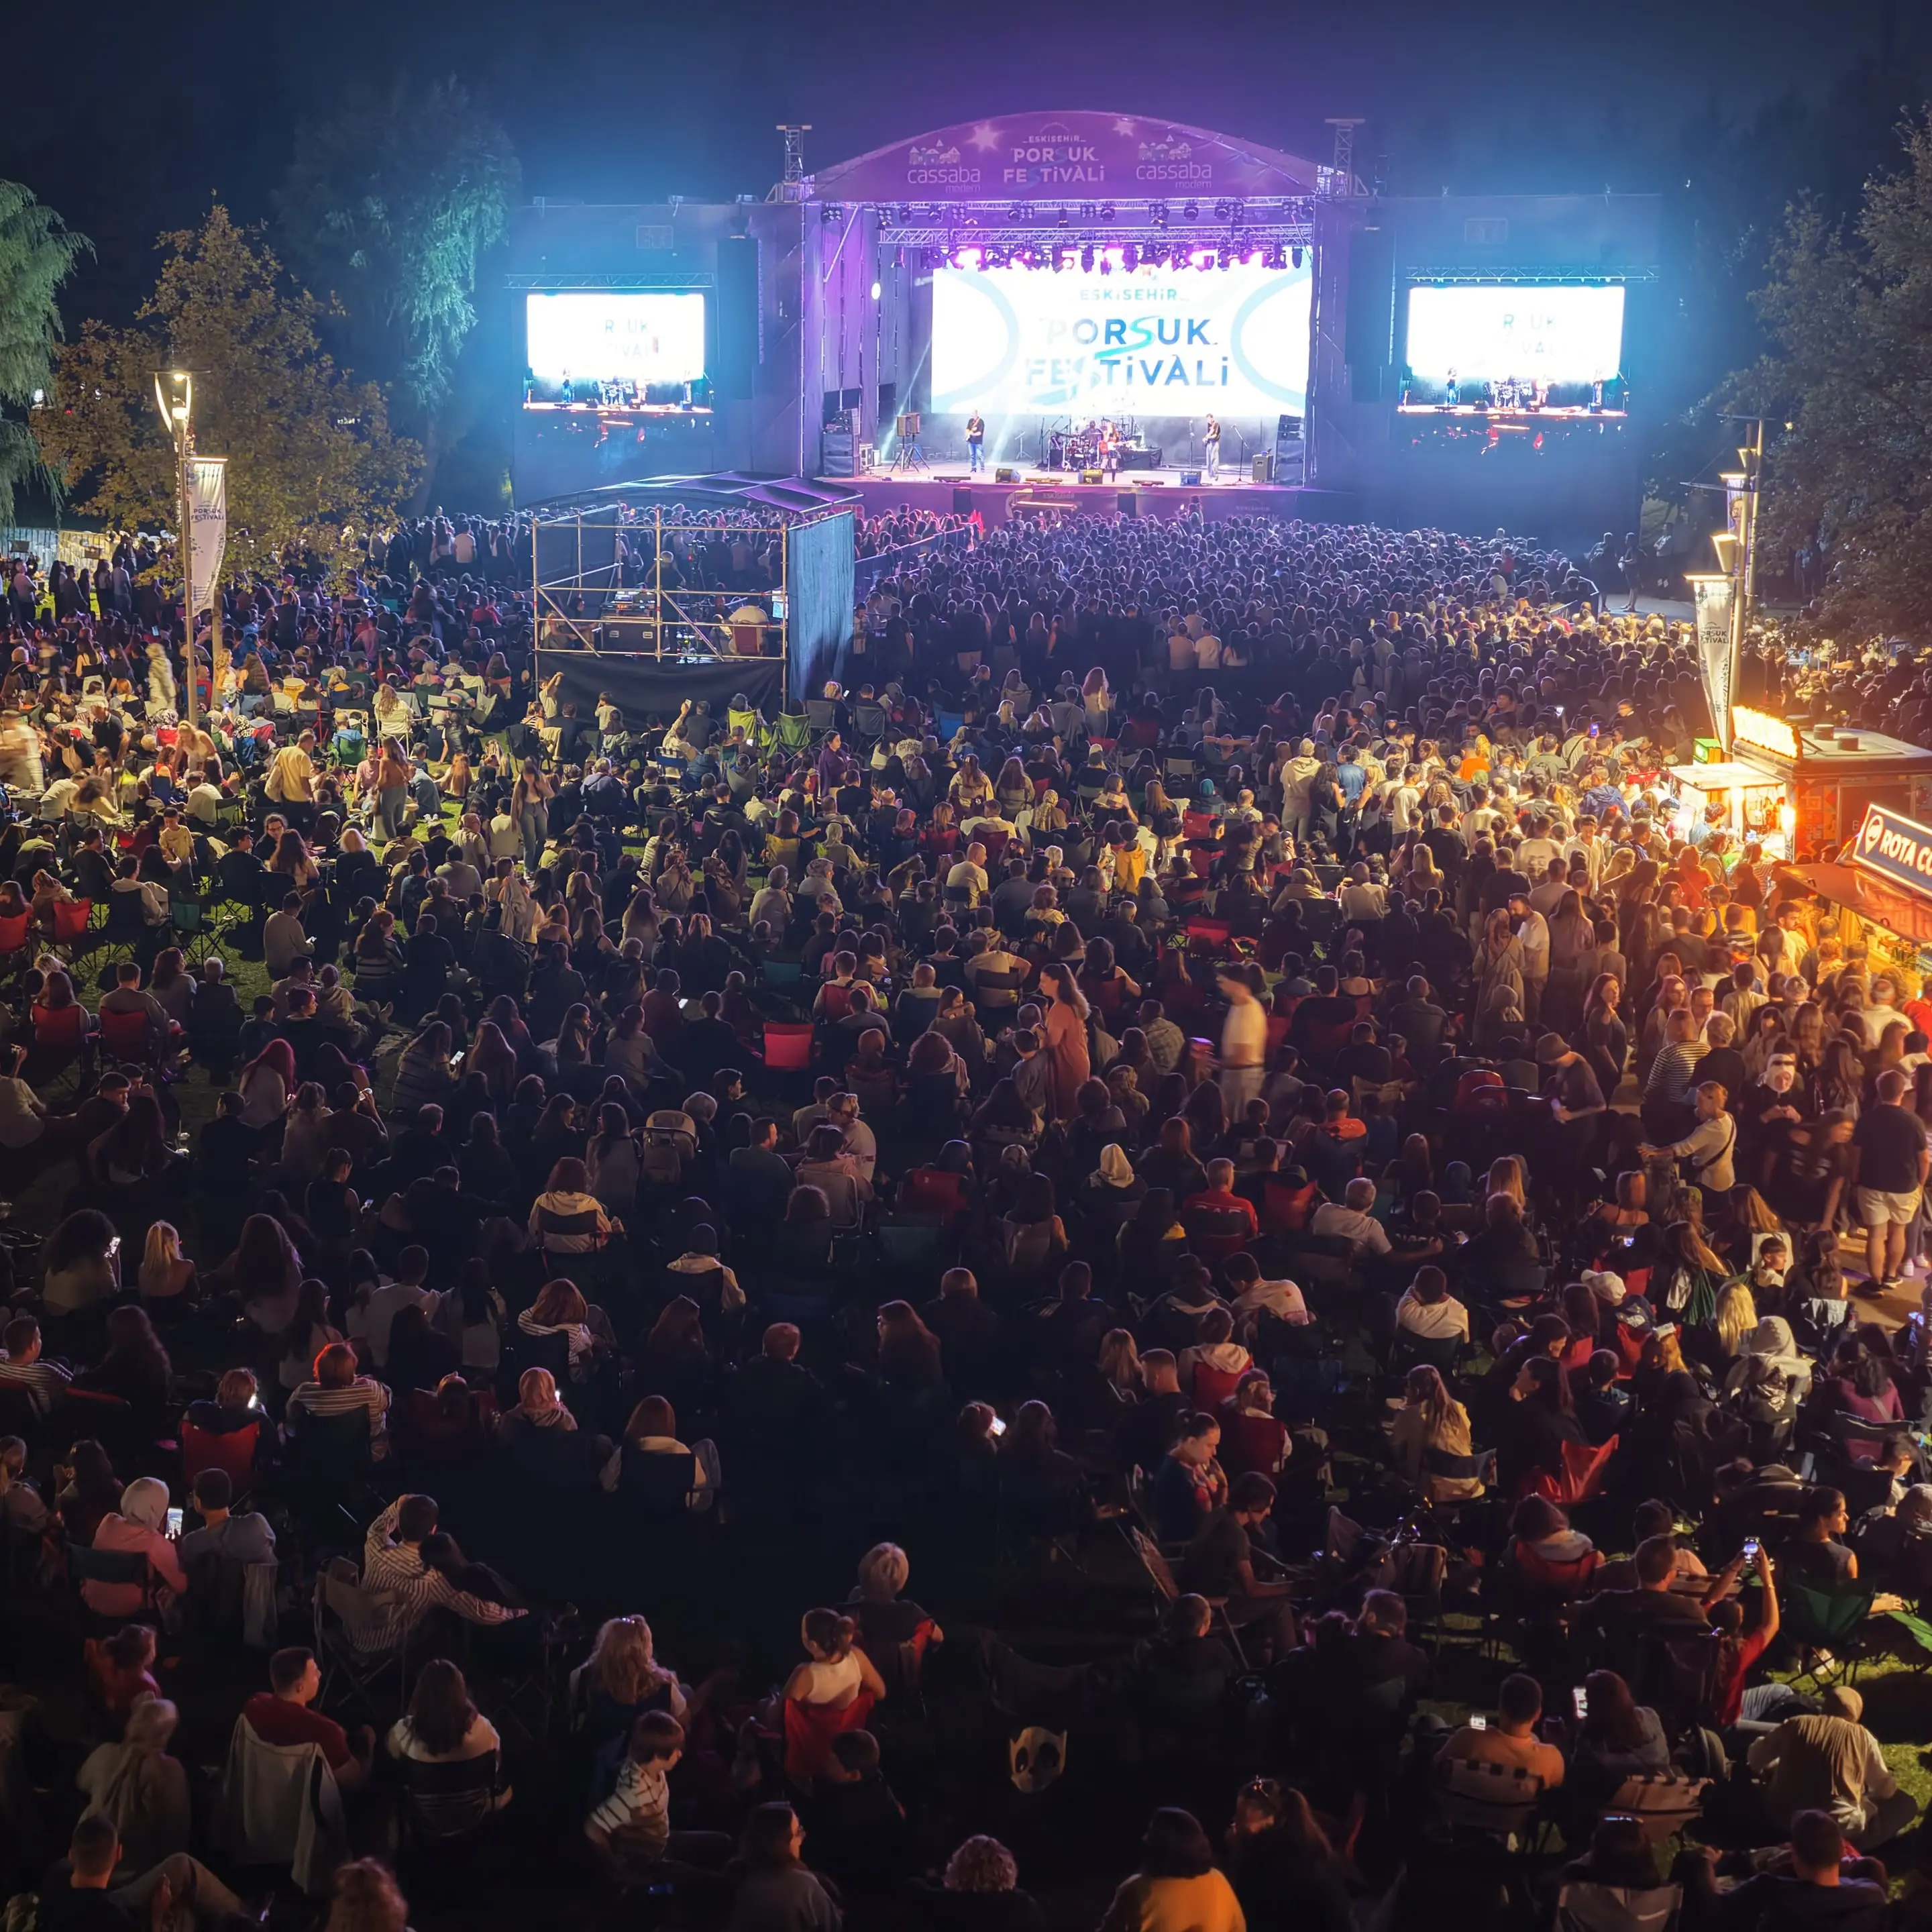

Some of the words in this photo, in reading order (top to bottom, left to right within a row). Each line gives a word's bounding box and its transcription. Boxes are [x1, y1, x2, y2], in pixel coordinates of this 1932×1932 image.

[1012, 146, 1099, 163] PORSUK
[907, 166, 981, 184] cassaba
[1136, 162, 1212, 180] cassaba
[945, 184, 981, 194] modern
[1175, 179, 1212, 189] modern
[1041, 315, 1218, 353] PORSUK
[1879, 828, 1917, 867] ROTA
